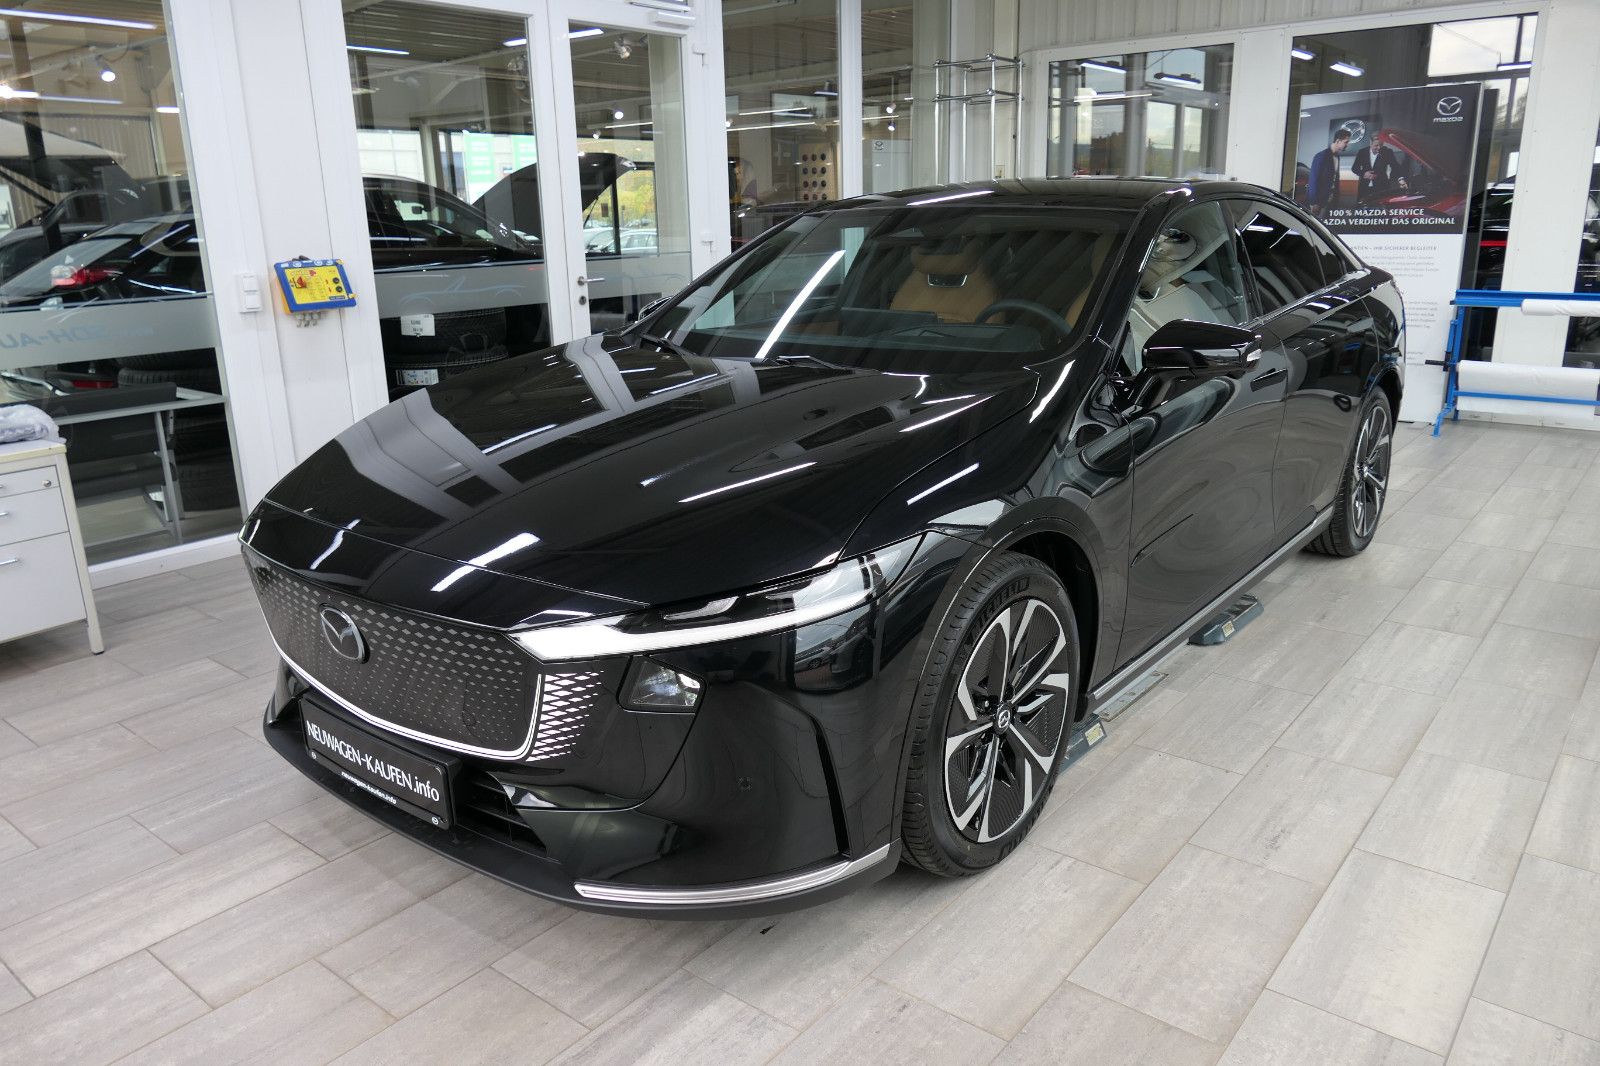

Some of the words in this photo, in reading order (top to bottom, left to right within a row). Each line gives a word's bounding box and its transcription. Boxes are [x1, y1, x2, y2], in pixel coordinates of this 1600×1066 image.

[1389, 208, 1425, 216] SERVICE
[1320, 218, 1346, 226] AZDA
[1391, 217, 1409, 225] DAS
[1412, 217, 1456, 225] ORIGINAL
[306, 720, 440, 802] NEUWAGEN-KAUFEN.info
